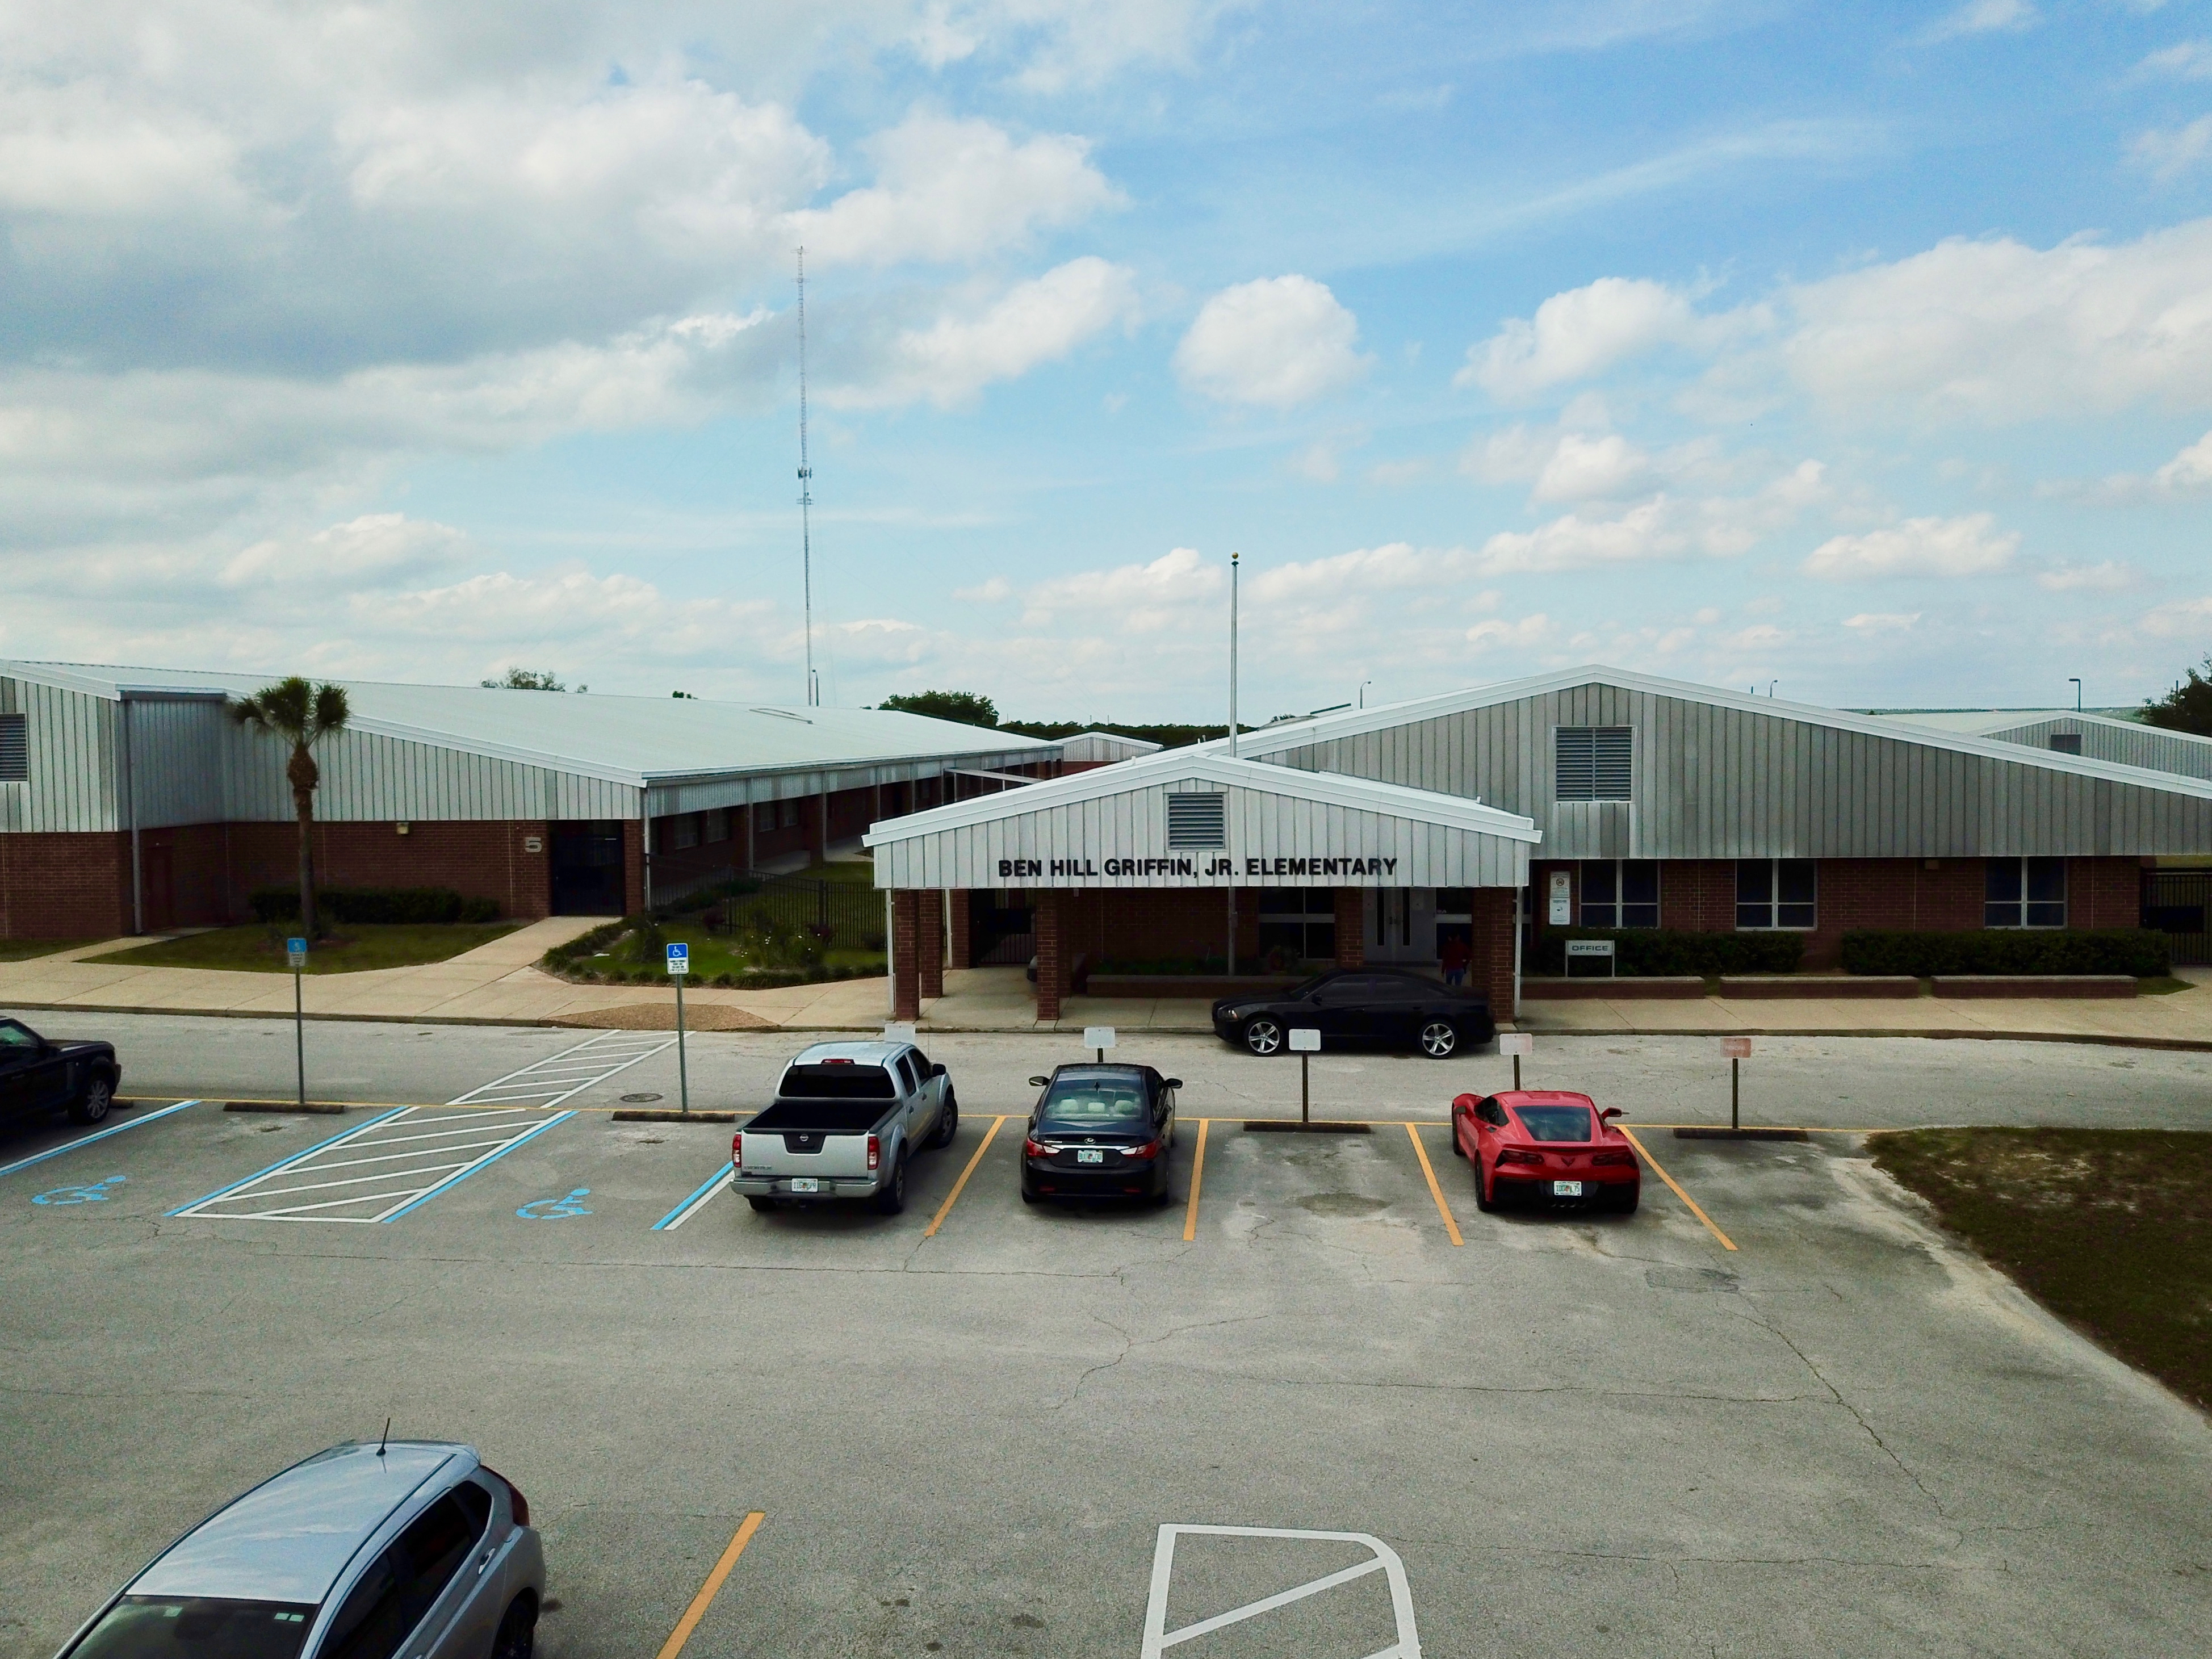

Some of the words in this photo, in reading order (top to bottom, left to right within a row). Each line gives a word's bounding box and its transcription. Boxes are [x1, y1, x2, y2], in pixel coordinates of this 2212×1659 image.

[525, 837, 542, 853] 5
[998, 859, 1042, 877] BEN
[1050, 859, 1098, 876] HILL
[1104, 858, 1197, 878] GRIFFIN,
[1205, 858, 1239, 876] JR.
[1247, 858, 1398, 875] ELEMENTARY
